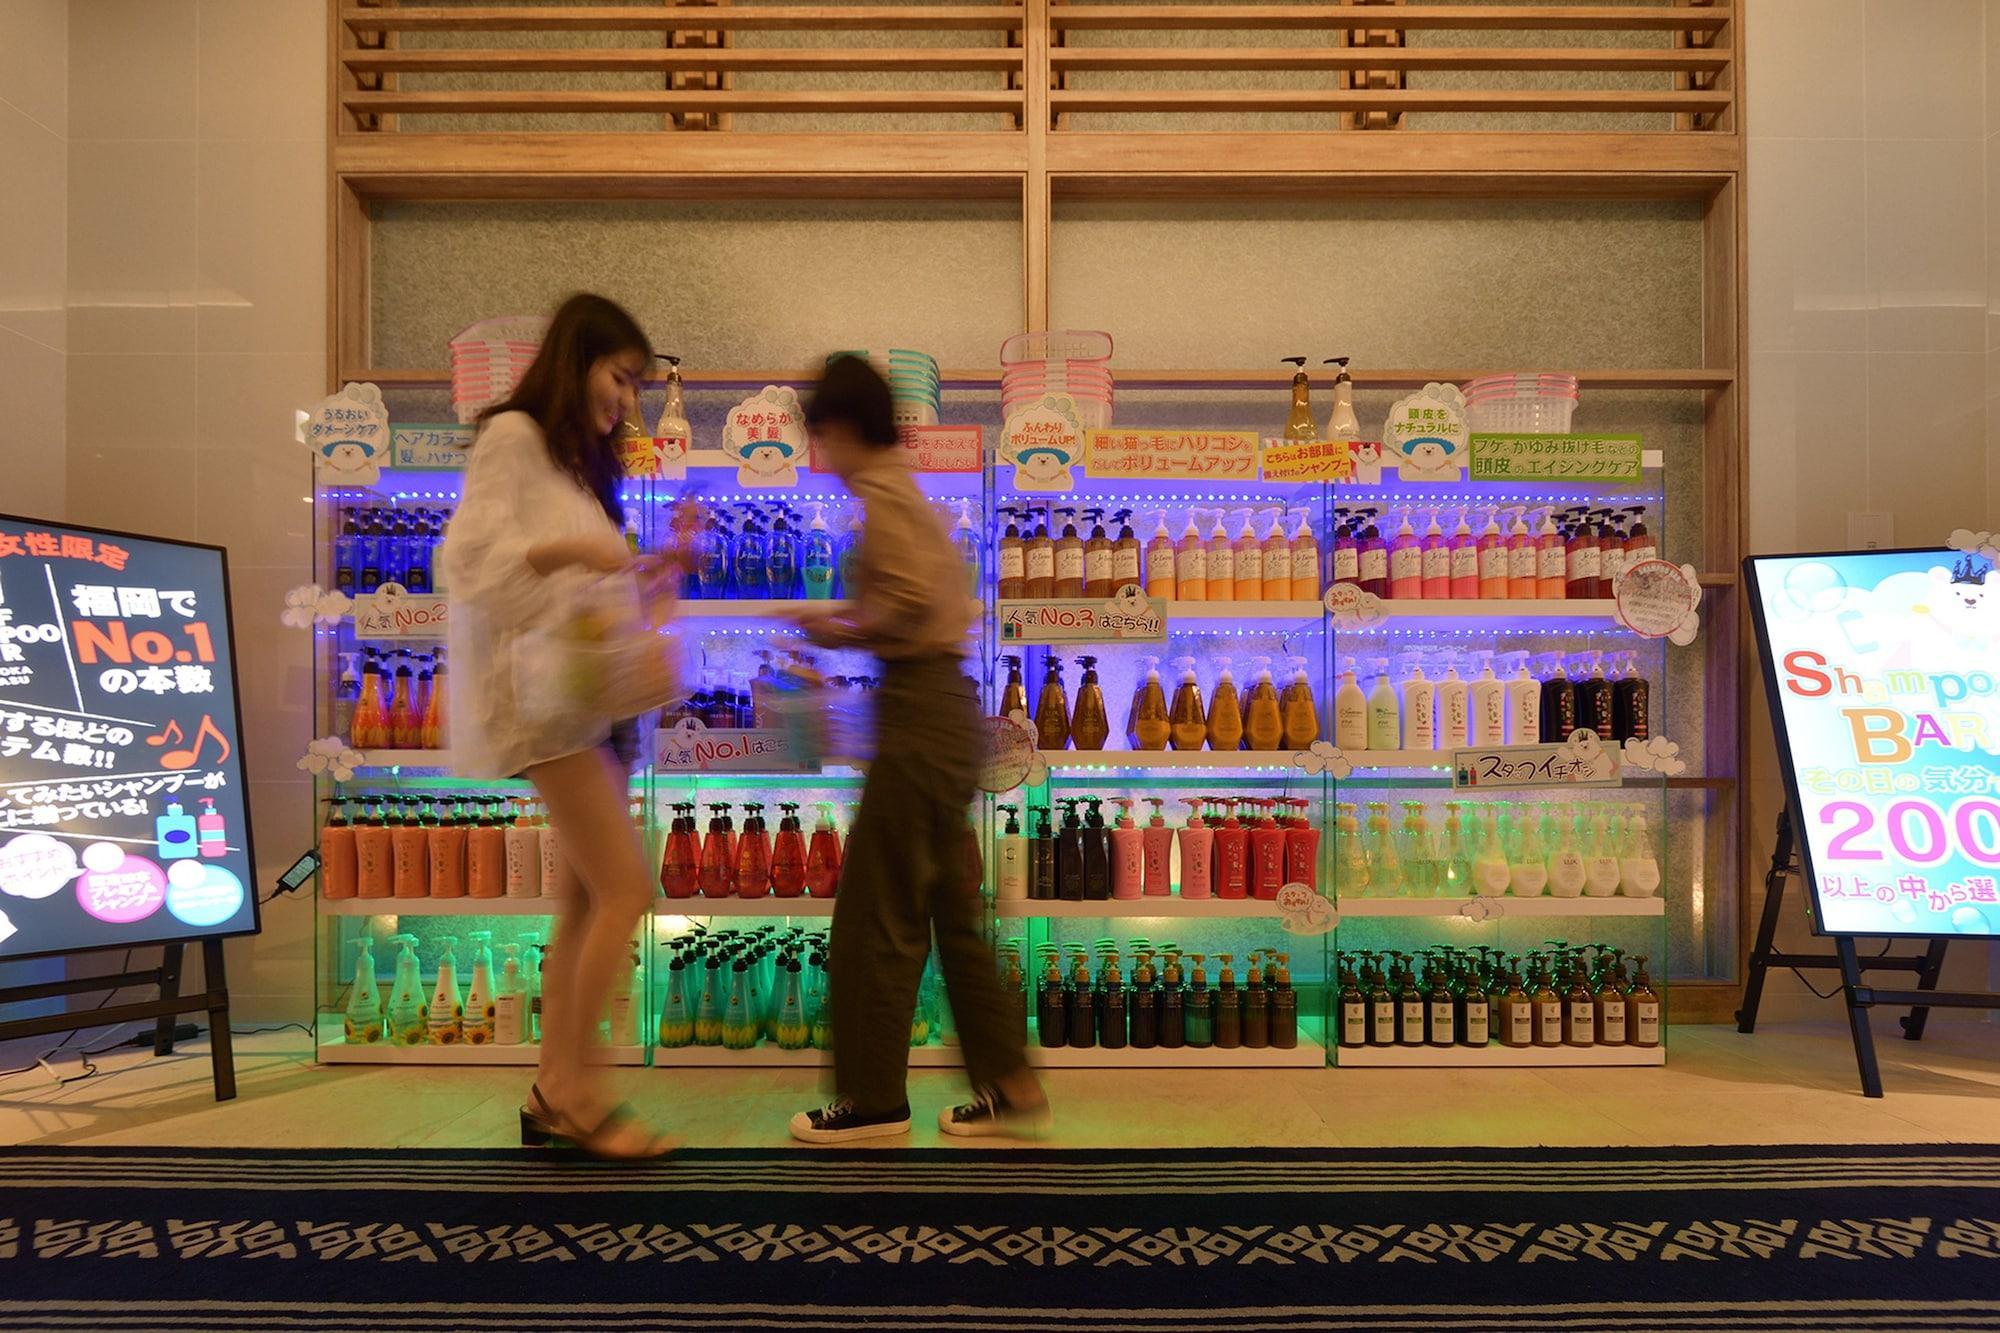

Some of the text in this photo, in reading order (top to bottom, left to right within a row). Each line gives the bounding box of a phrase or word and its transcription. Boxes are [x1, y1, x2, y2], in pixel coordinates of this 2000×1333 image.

[324, 408, 368, 421] うるおい
[736, 412, 792, 425] なめらか
[1023, 422, 1062, 433] ふんわり
[1394, 422, 1460, 434] ナチュラルに
[1408, 408, 1448, 420] 頭皮を
[0, 532, 130, 571] 女性限定
[71, 584, 197, 618] 福岡で
[72, 620, 216, 664] No.1
[100, 665, 215, 694] の本数
[1842, 707, 1992, 763] BAR
[1819, 801, 2000, 863] 200
[1822, 875, 1998, 911] 以上の中から選
